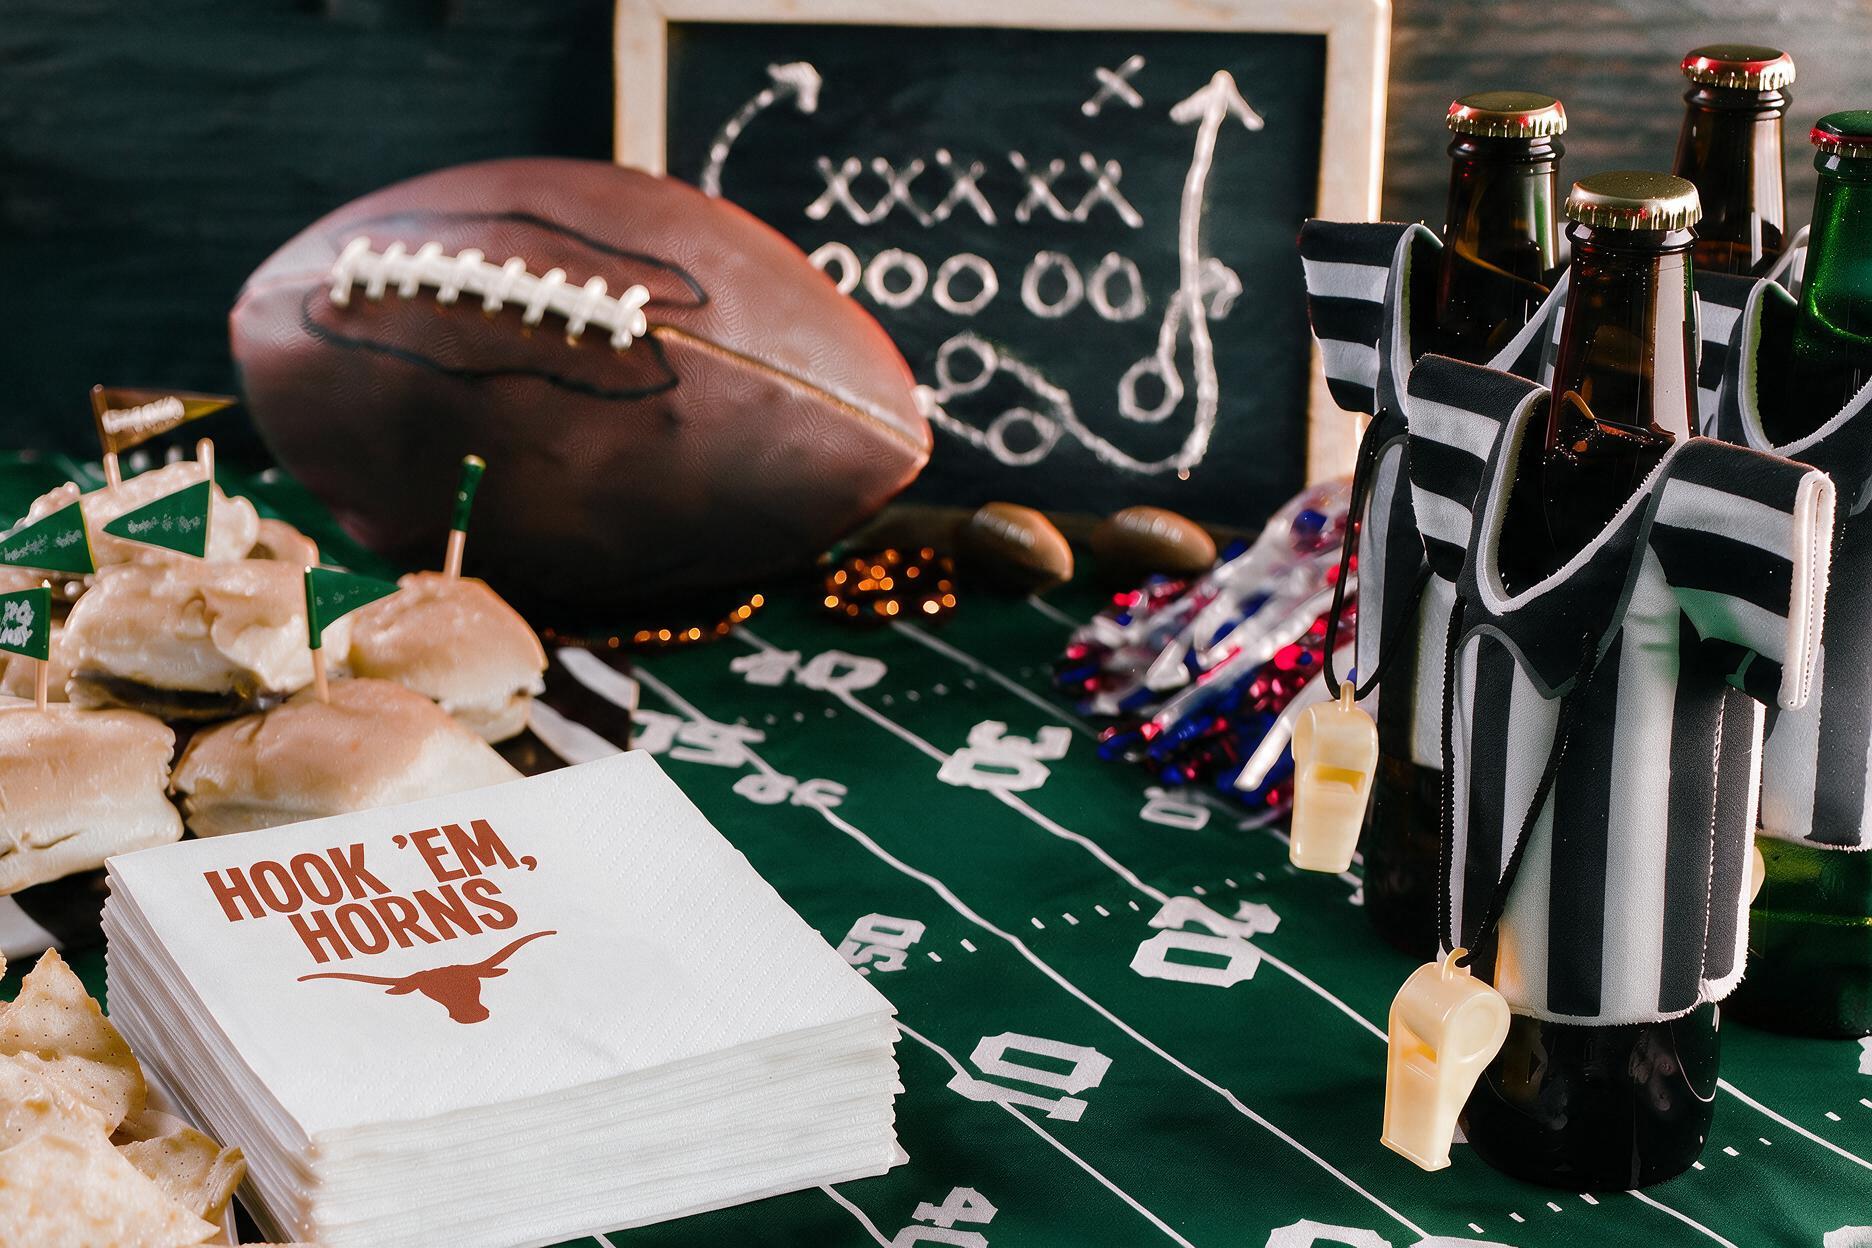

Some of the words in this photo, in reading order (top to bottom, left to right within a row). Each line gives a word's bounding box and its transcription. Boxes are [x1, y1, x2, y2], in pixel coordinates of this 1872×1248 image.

[203, 843, 392, 922] HOOK
[392, 819, 537, 883] 'EM,
[287, 878, 518, 964] HORNS
[1129, 896, 1281, 988] 20
[946, 1031, 1113, 1122] 10
